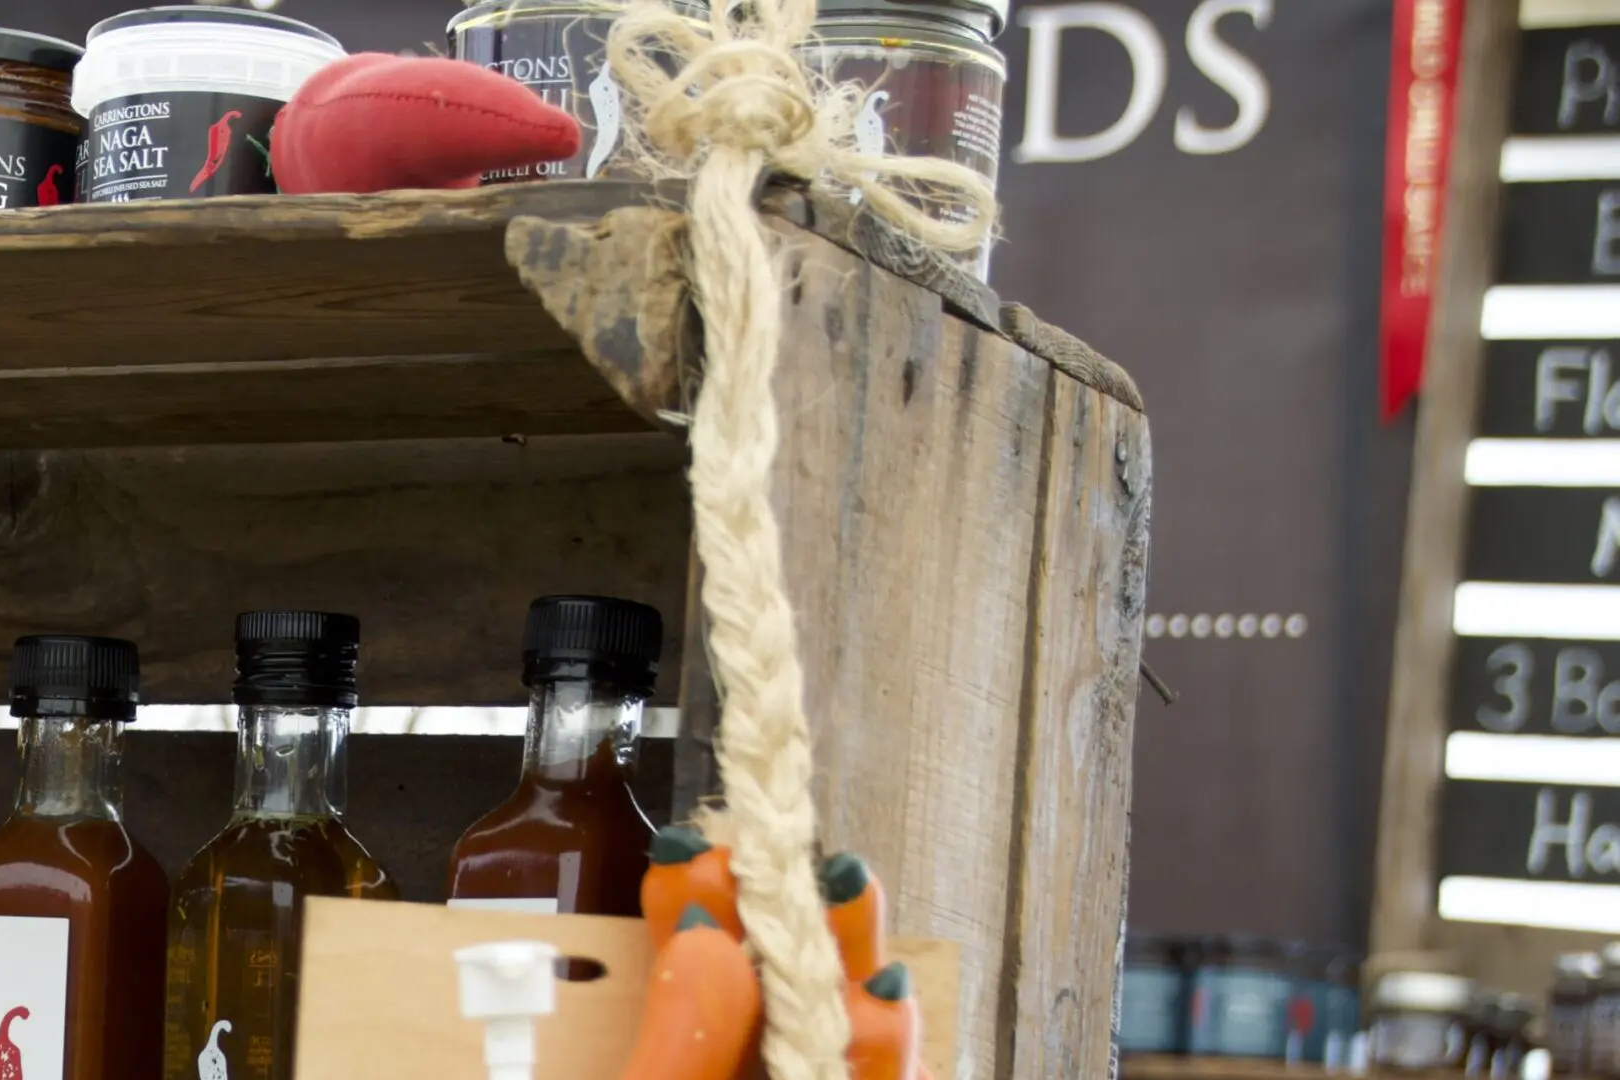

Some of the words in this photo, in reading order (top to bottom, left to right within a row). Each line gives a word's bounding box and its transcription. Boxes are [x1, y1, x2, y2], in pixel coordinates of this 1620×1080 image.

[94, 102, 170, 128] CARRINGTONS
[100, 125, 153, 153] NAGA
[93, 154, 116, 180] SEA
[119, 146, 168, 172] SALT
[1476, 643, 1534, 732] 3
